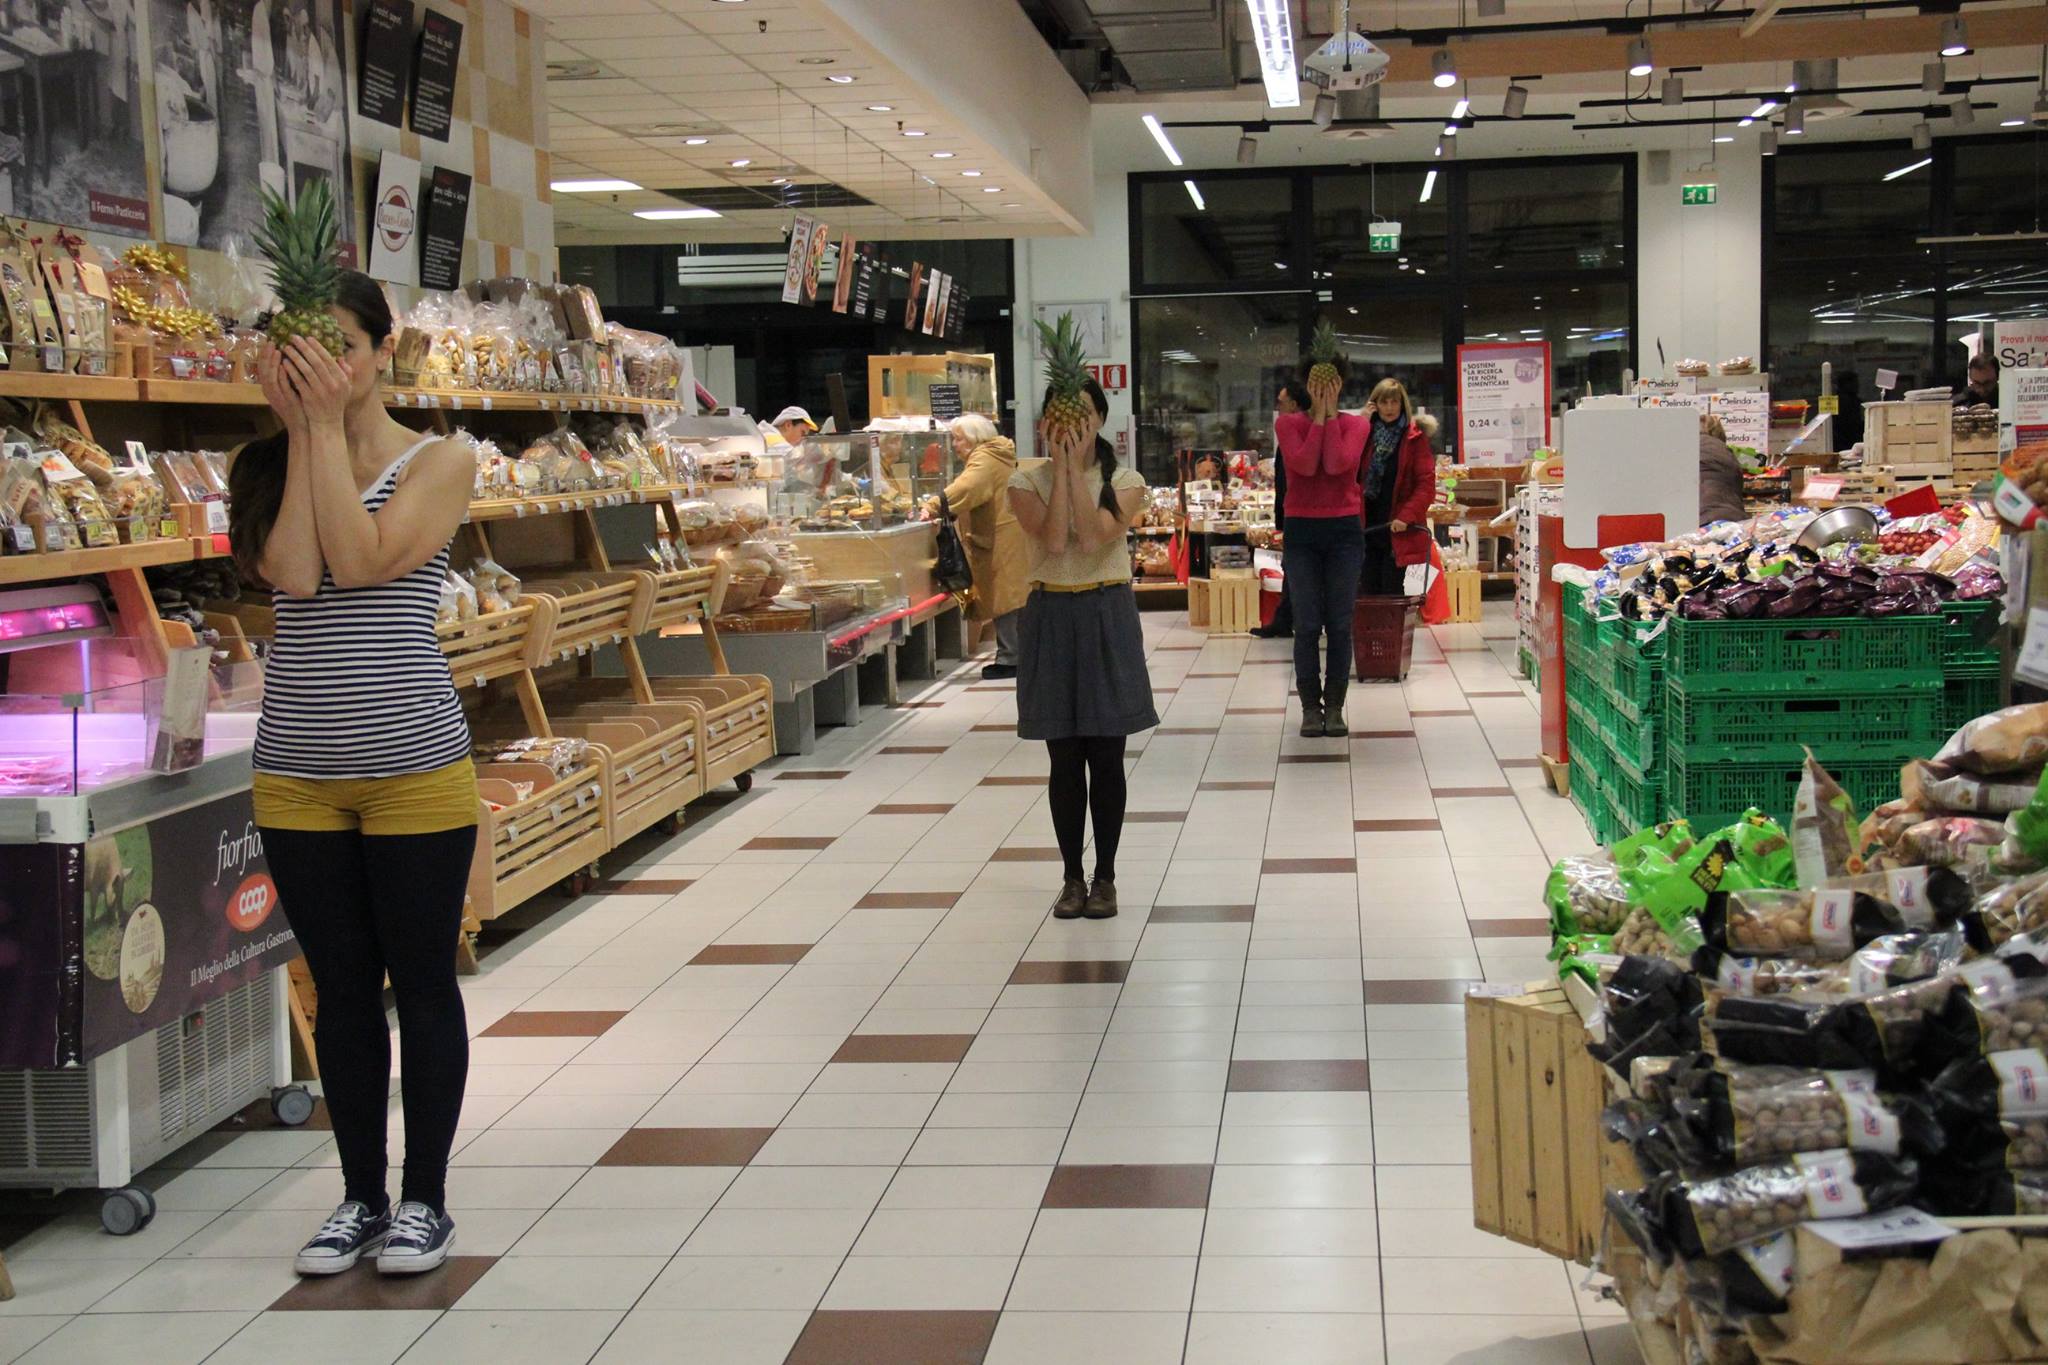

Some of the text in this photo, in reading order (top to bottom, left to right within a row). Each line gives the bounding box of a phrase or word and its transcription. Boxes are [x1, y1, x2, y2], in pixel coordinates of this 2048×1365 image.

[2000, 336, 2025, 345] Prova
[1467, 362, 1496, 370] SOSTIENI
[1467, 380, 1510, 388] DIMENTICARE
[1647, 379, 1679, 389] Melinda
[1659, 400, 1692, 408] Melinda
[1719, 397, 1752, 406] Melinda
[1719, 416, 1751, 424] Melinda
[1725, 434, 1751, 442] elinda
[239, 884, 268, 916] coop
[199, 957, 223, 984] Meglio
[224, 948, 240, 970] della
[240, 940, 266, 962] Cultura
